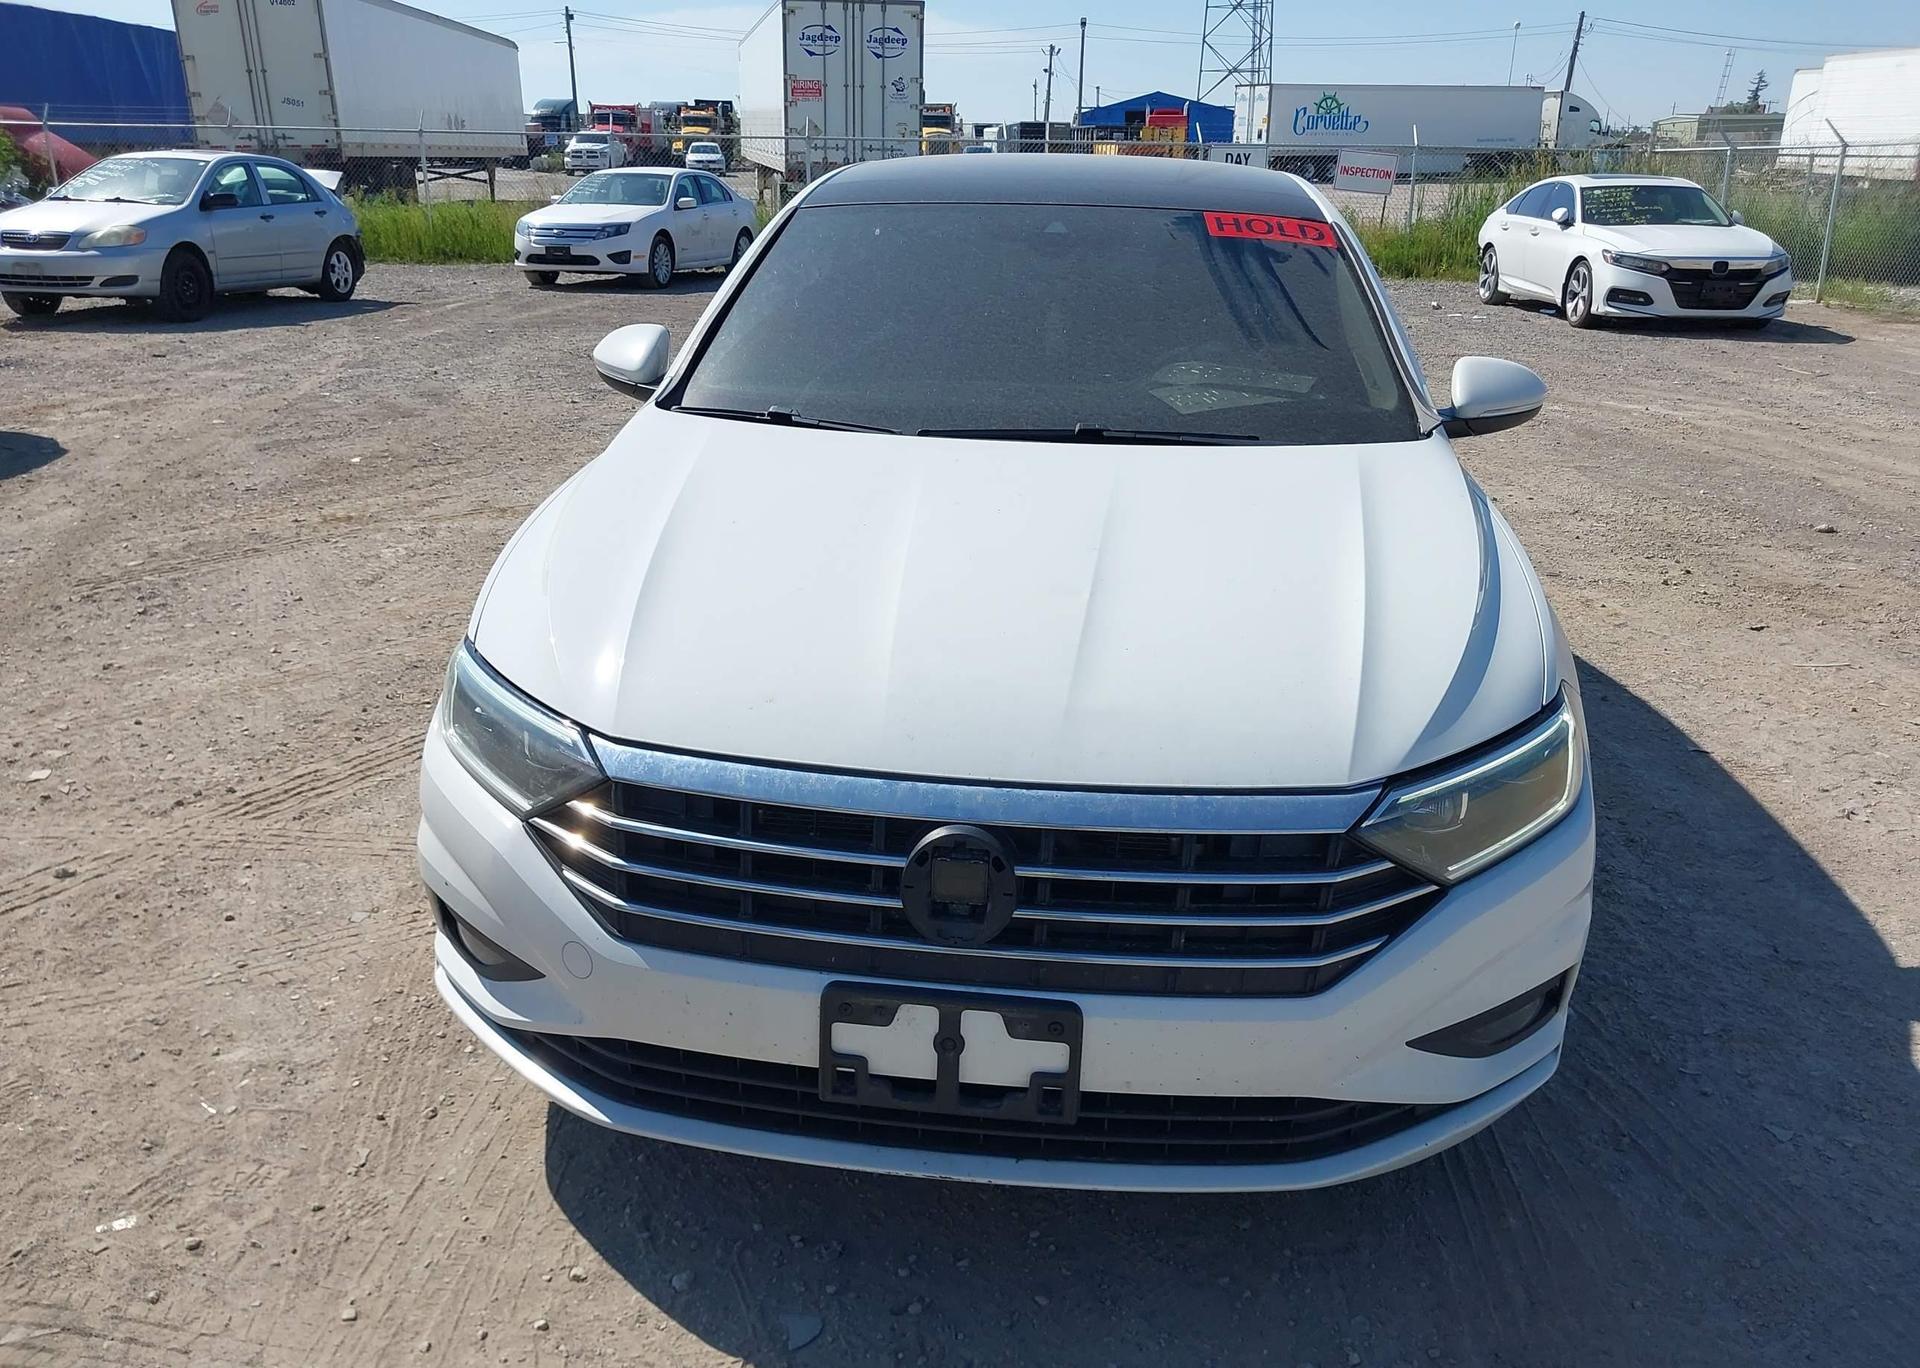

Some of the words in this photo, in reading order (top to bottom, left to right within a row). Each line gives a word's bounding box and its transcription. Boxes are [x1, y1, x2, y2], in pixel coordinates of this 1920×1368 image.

[799, 32, 841, 43] Jagdeep
[866, 34, 908, 46] Jagdeep
[281, 97, 304, 107] JS051
[1293, 106, 1369, 136] Corvette
[1226, 153, 1252, 165] DAY
[1340, 165, 1392, 180] INSPECTION
[1215, 217, 1325, 241] HOLD
